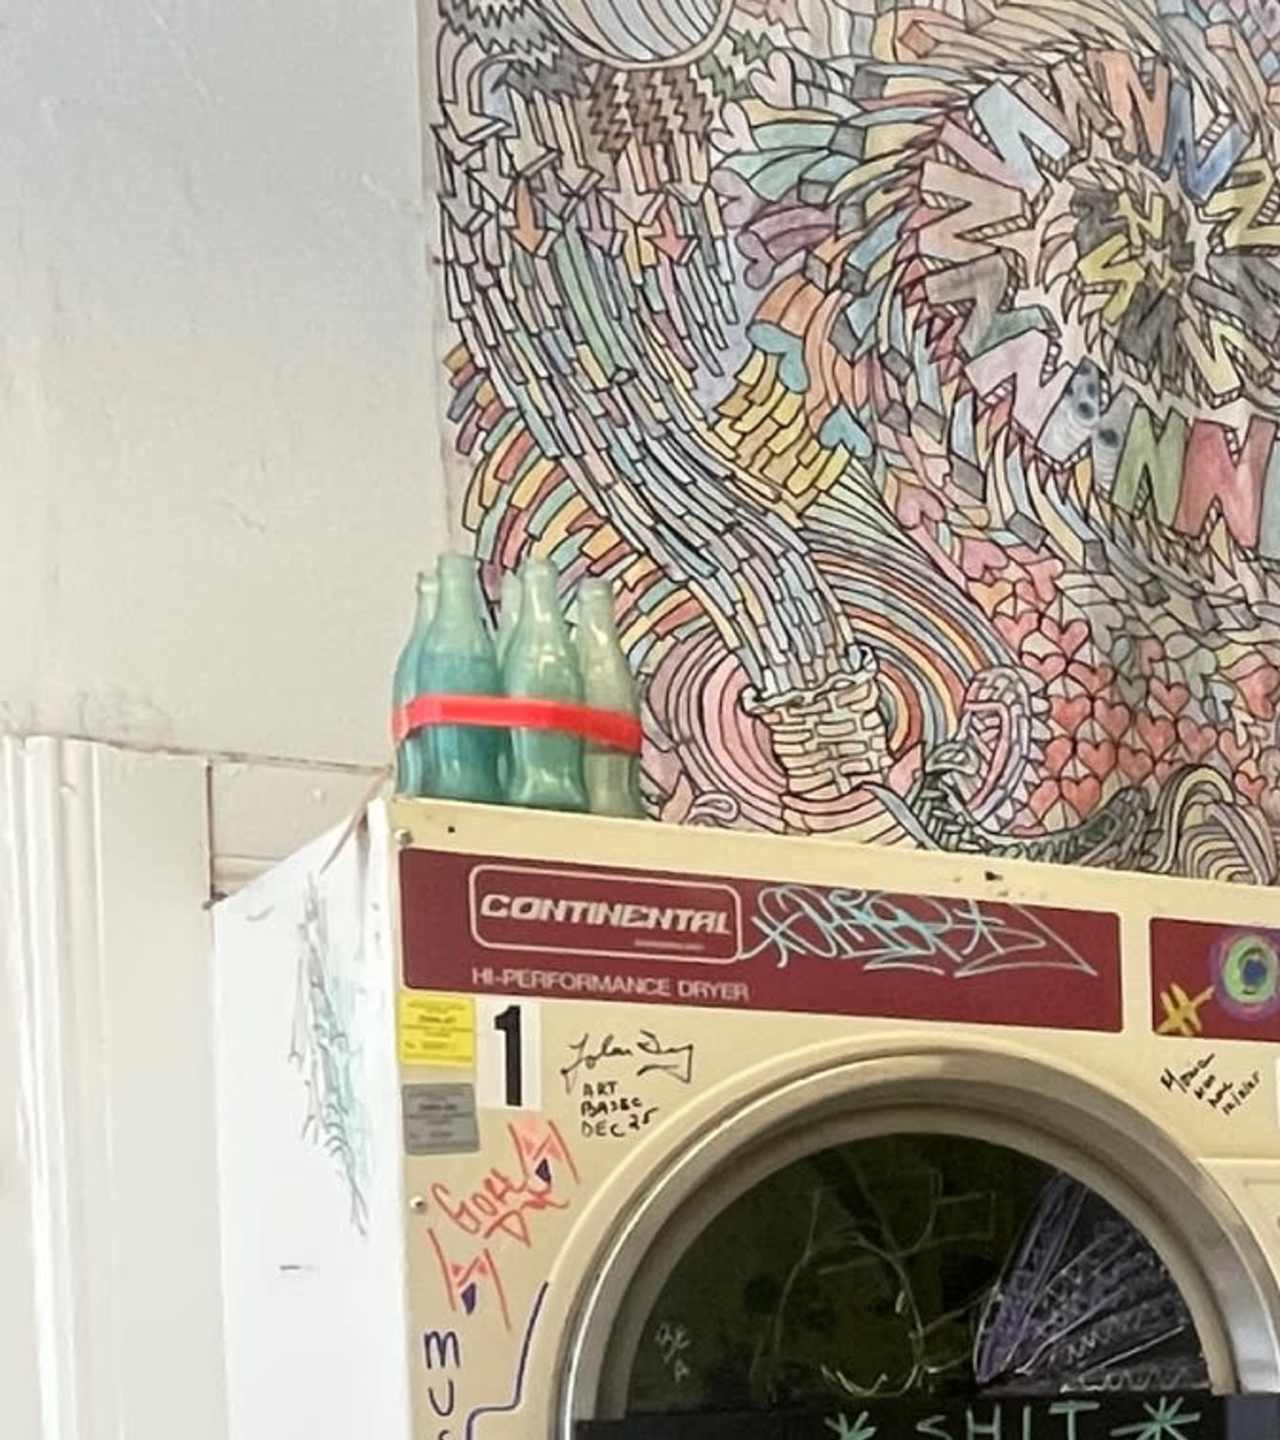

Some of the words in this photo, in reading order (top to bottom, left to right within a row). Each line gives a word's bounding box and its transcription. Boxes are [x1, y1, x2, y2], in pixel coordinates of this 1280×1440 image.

[479, 892, 733, 937] CONTINENTAL
[471, 965, 672, 998] HI-PERFORMANCE
[676, 978, 750, 1003] DRYER
[494, 1005, 523, 1107] 1
